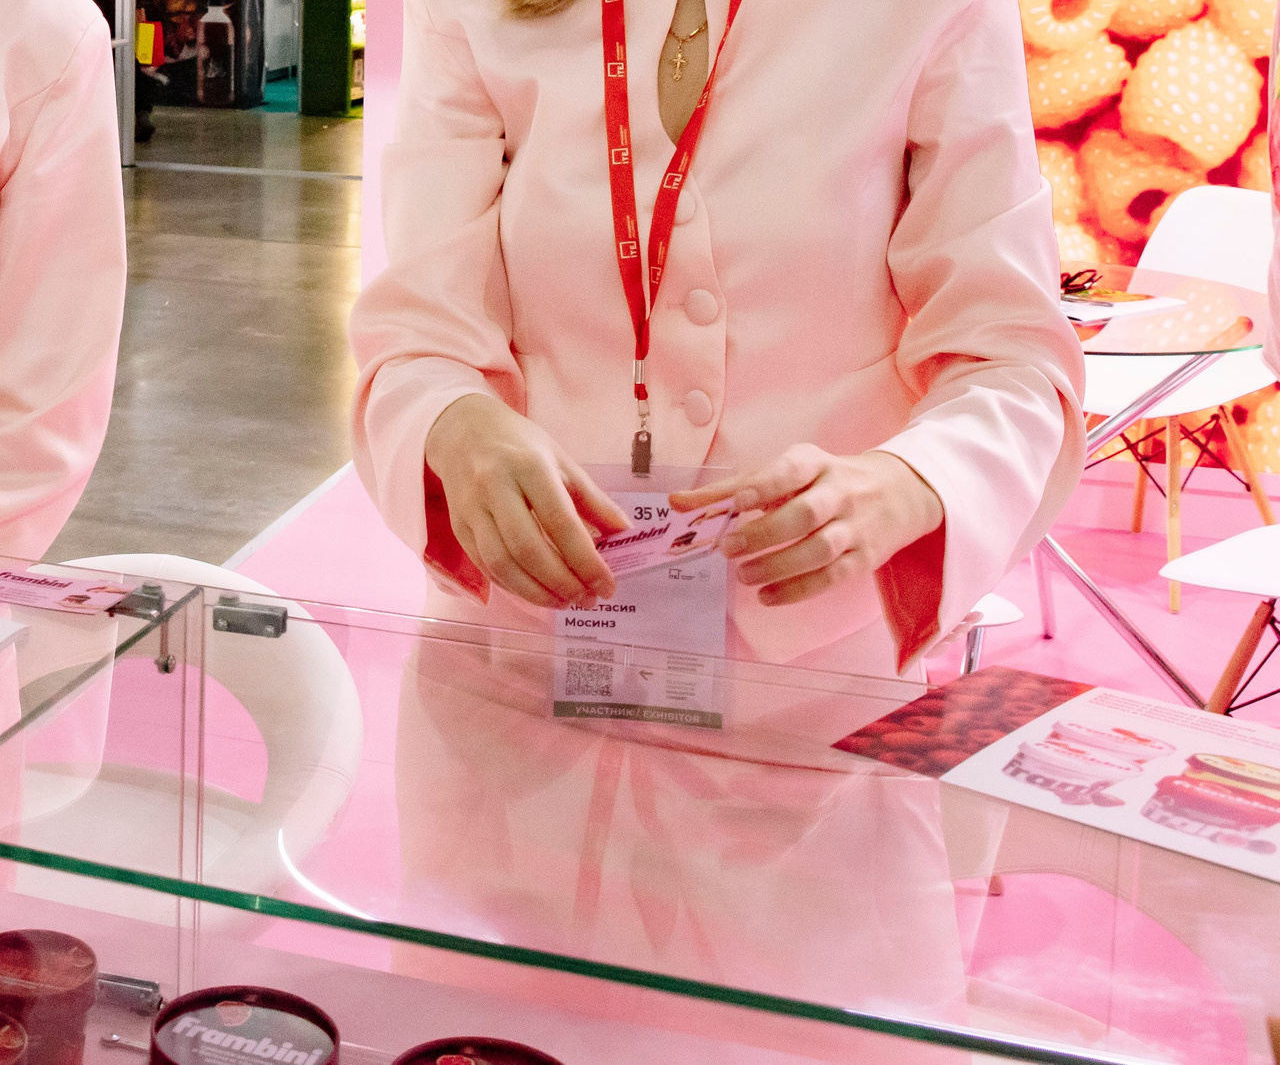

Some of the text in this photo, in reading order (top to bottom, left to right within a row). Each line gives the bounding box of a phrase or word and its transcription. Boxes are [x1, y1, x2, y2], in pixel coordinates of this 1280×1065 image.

[633, 506, 653, 521] 35
[564, 617, 617, 629] Мосинз
[575, 705, 634, 718] УЧАСТНИК
